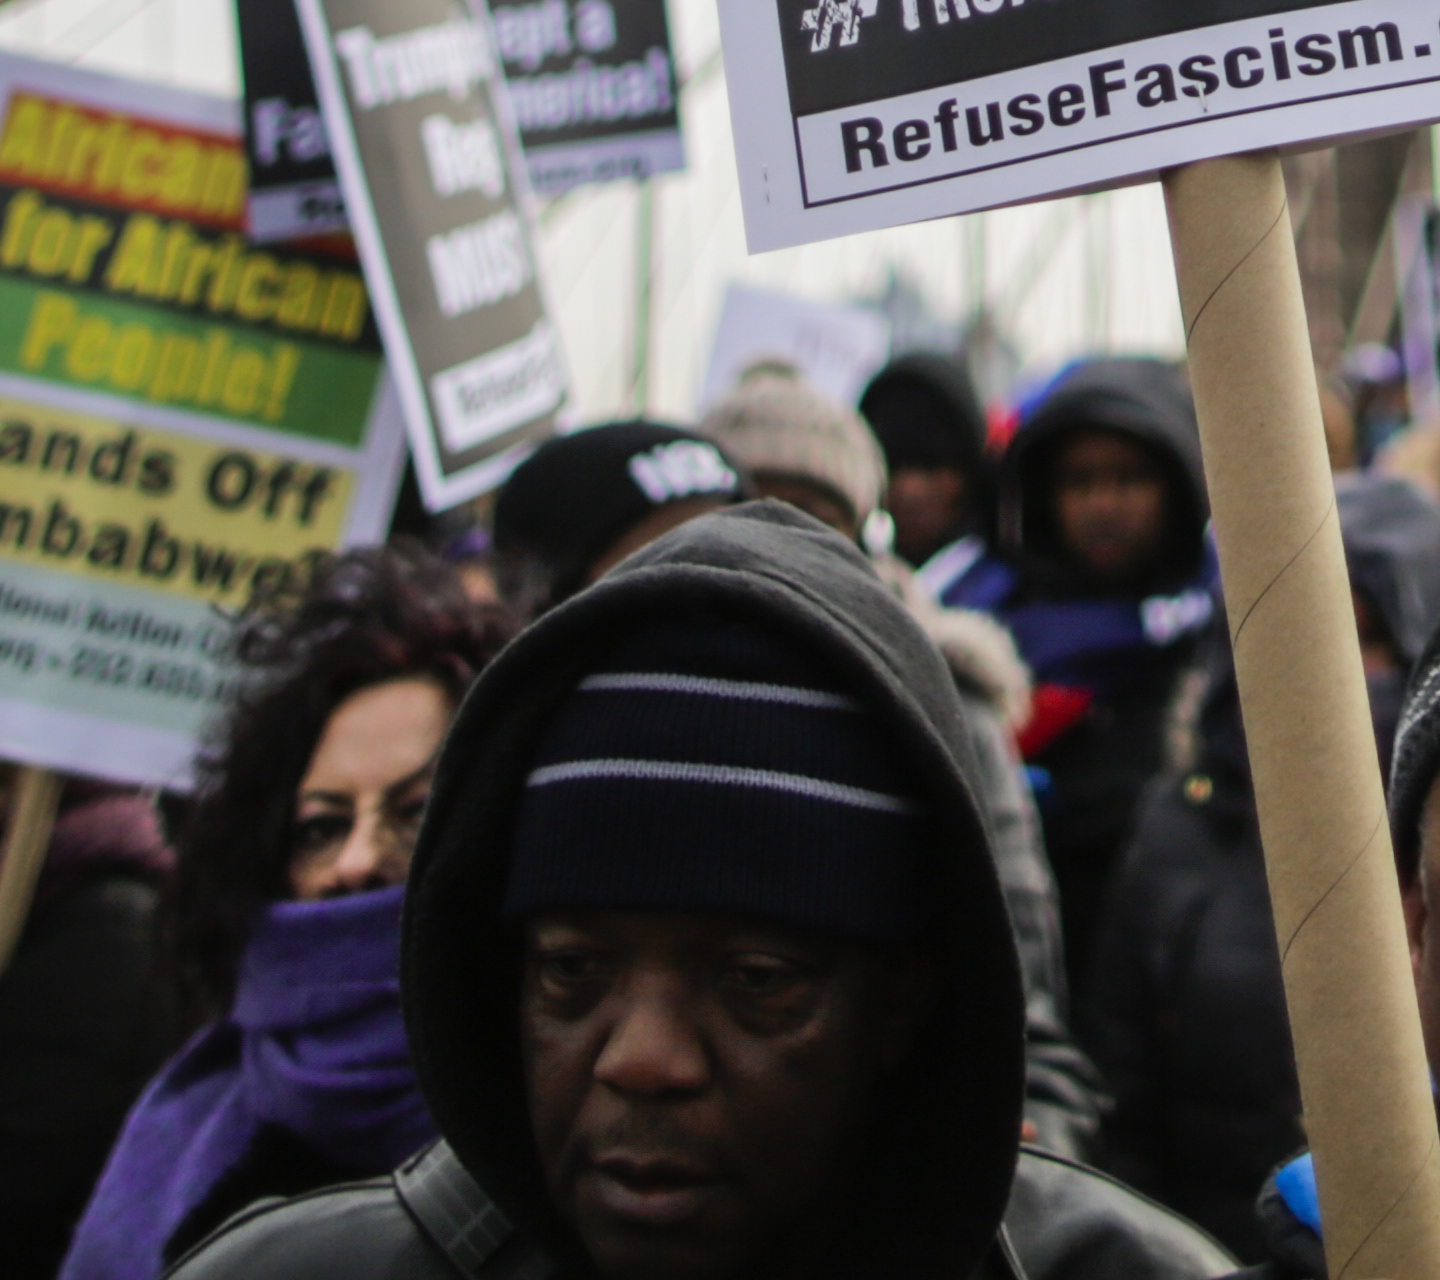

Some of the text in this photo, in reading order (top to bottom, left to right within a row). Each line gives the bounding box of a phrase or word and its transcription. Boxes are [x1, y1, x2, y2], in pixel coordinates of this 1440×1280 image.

[106, 219, 365, 339] African
[19, 295, 299, 420] People!
[207, 452, 336, 528] Off
